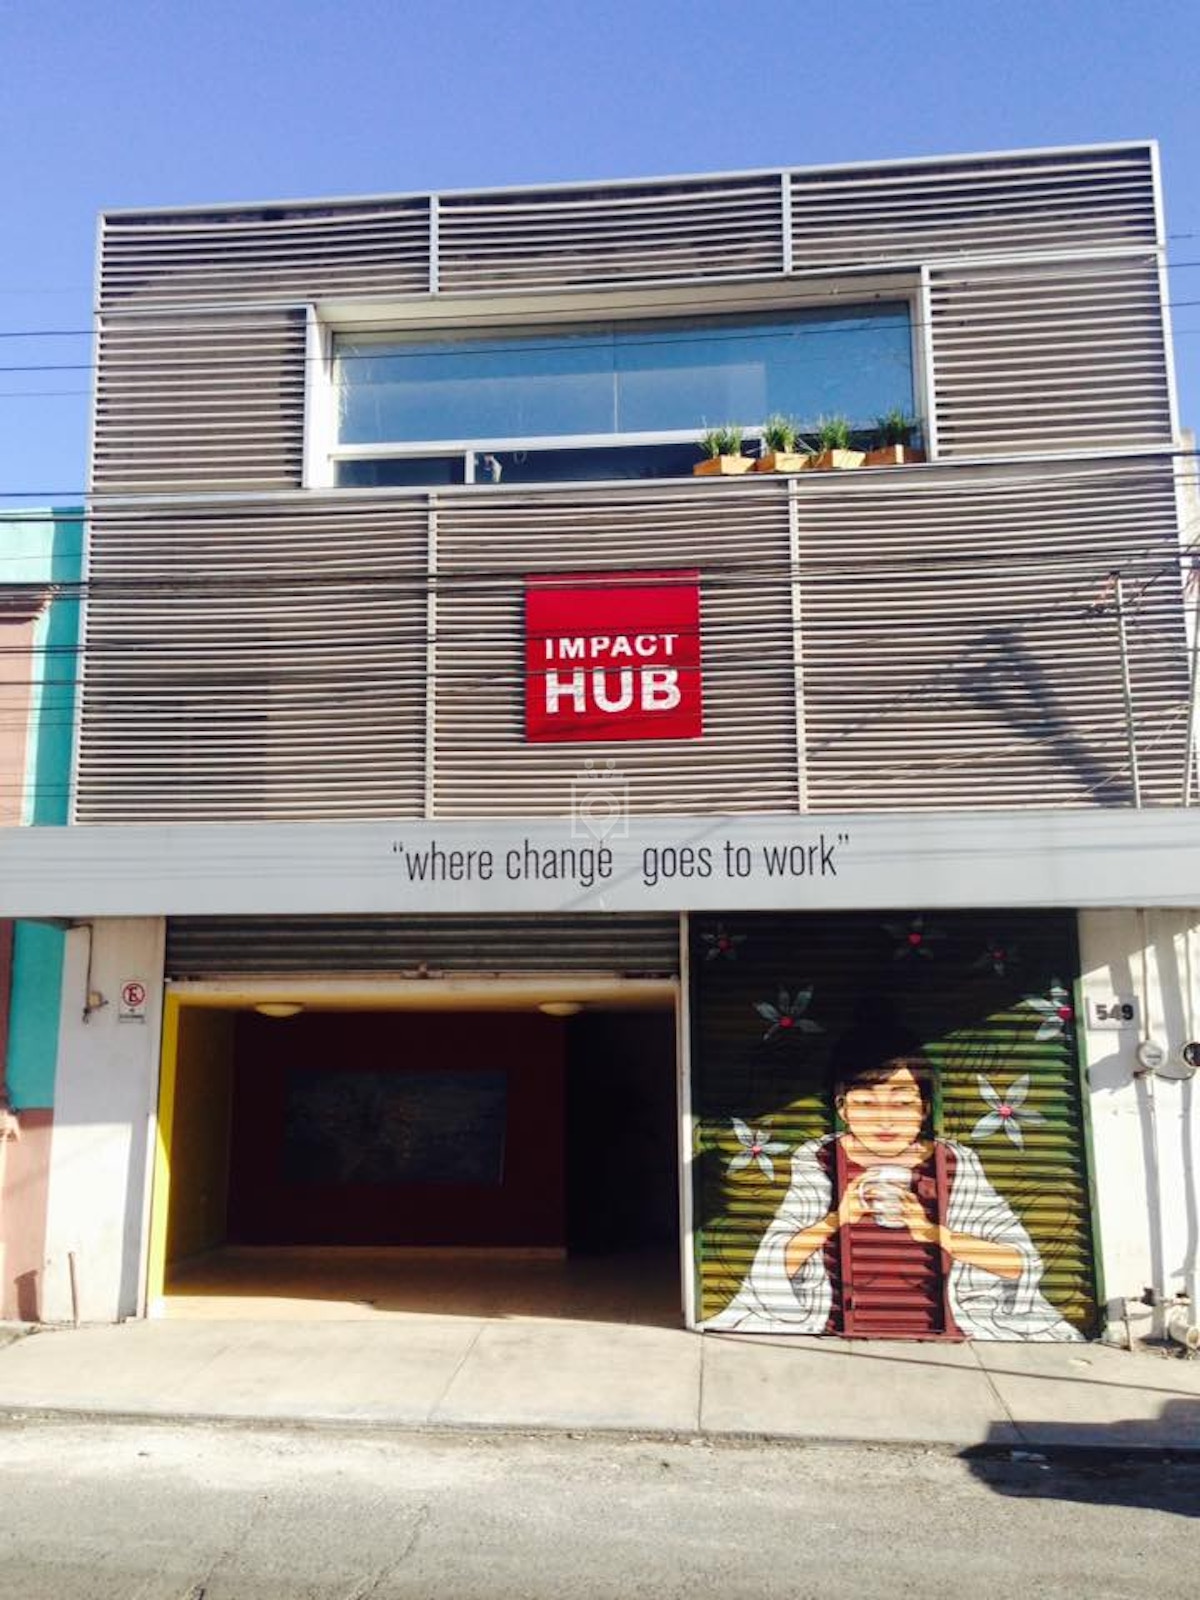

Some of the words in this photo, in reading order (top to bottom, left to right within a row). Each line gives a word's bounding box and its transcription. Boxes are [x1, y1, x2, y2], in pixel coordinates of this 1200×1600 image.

[545, 633, 679, 659] IMPACT
[545, 664, 681, 713] HUB
[506, 837, 613, 887] change
[643, 847, 712, 886] goes
[724, 840, 751, 877] to
[1095, 1003, 1134, 1020] 549
